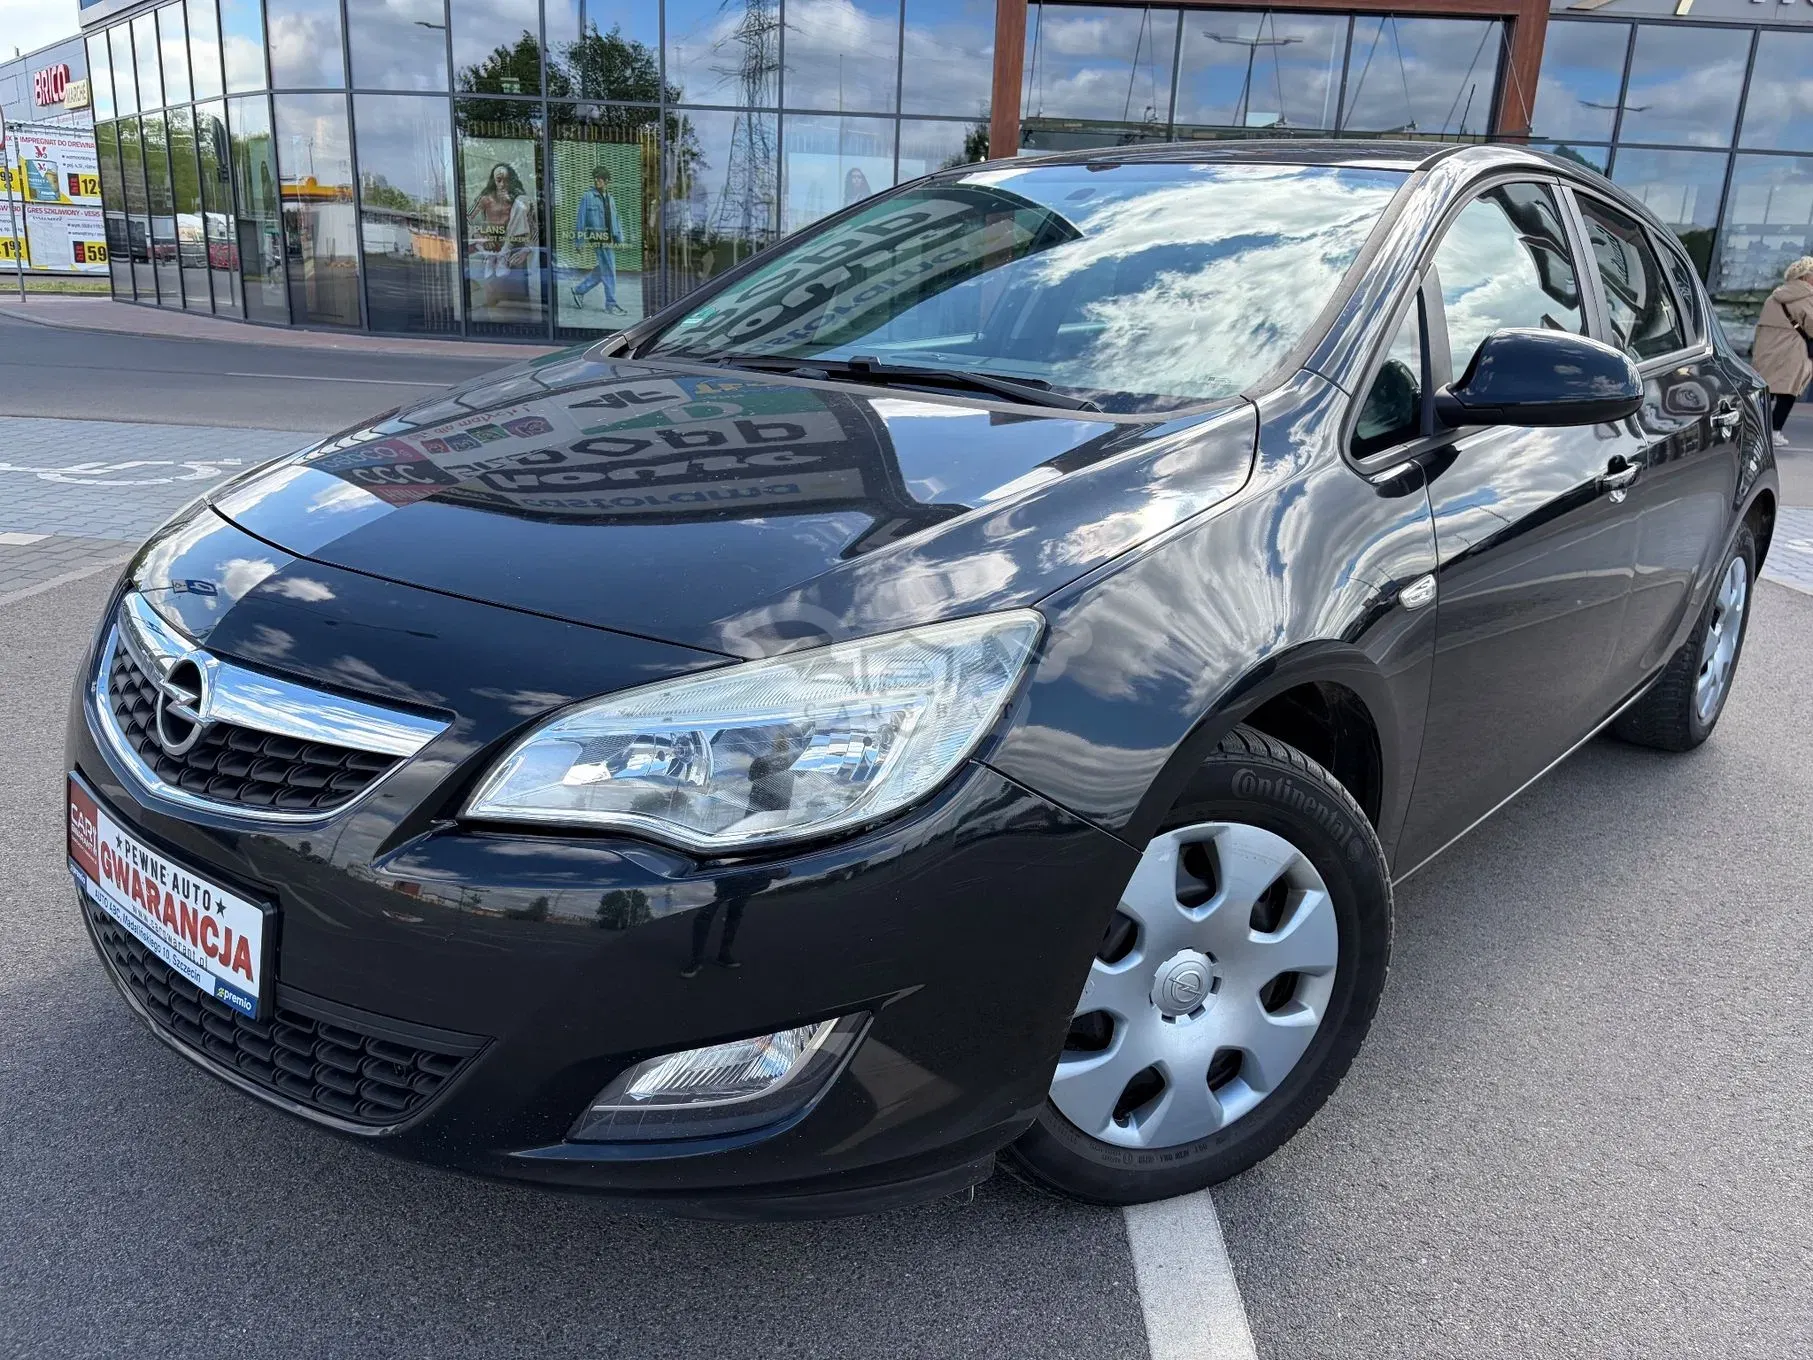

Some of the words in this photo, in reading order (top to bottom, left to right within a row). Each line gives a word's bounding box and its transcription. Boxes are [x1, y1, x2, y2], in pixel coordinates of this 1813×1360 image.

[34, 64, 68, 106] BRICO
[27, 206, 43, 214] GRES
[474, 225, 506, 235] PLANS
[561, 230, 576, 239] NO
[577, 231, 609, 241] PLANS
[87, 245, 107, 262] 59
[1231, 768, 1353, 847] Continental
[124, 839, 167, 887] PEWNE
[172, 872, 212, 912] AUTO
[100, 840, 254, 984] GWARANCJA
[94, 889, 109, 909] AUTO
[162, 946, 172, 963] 10,
[172, 954, 202, 983] Szczecin
[223, 988, 252, 1011] premio
